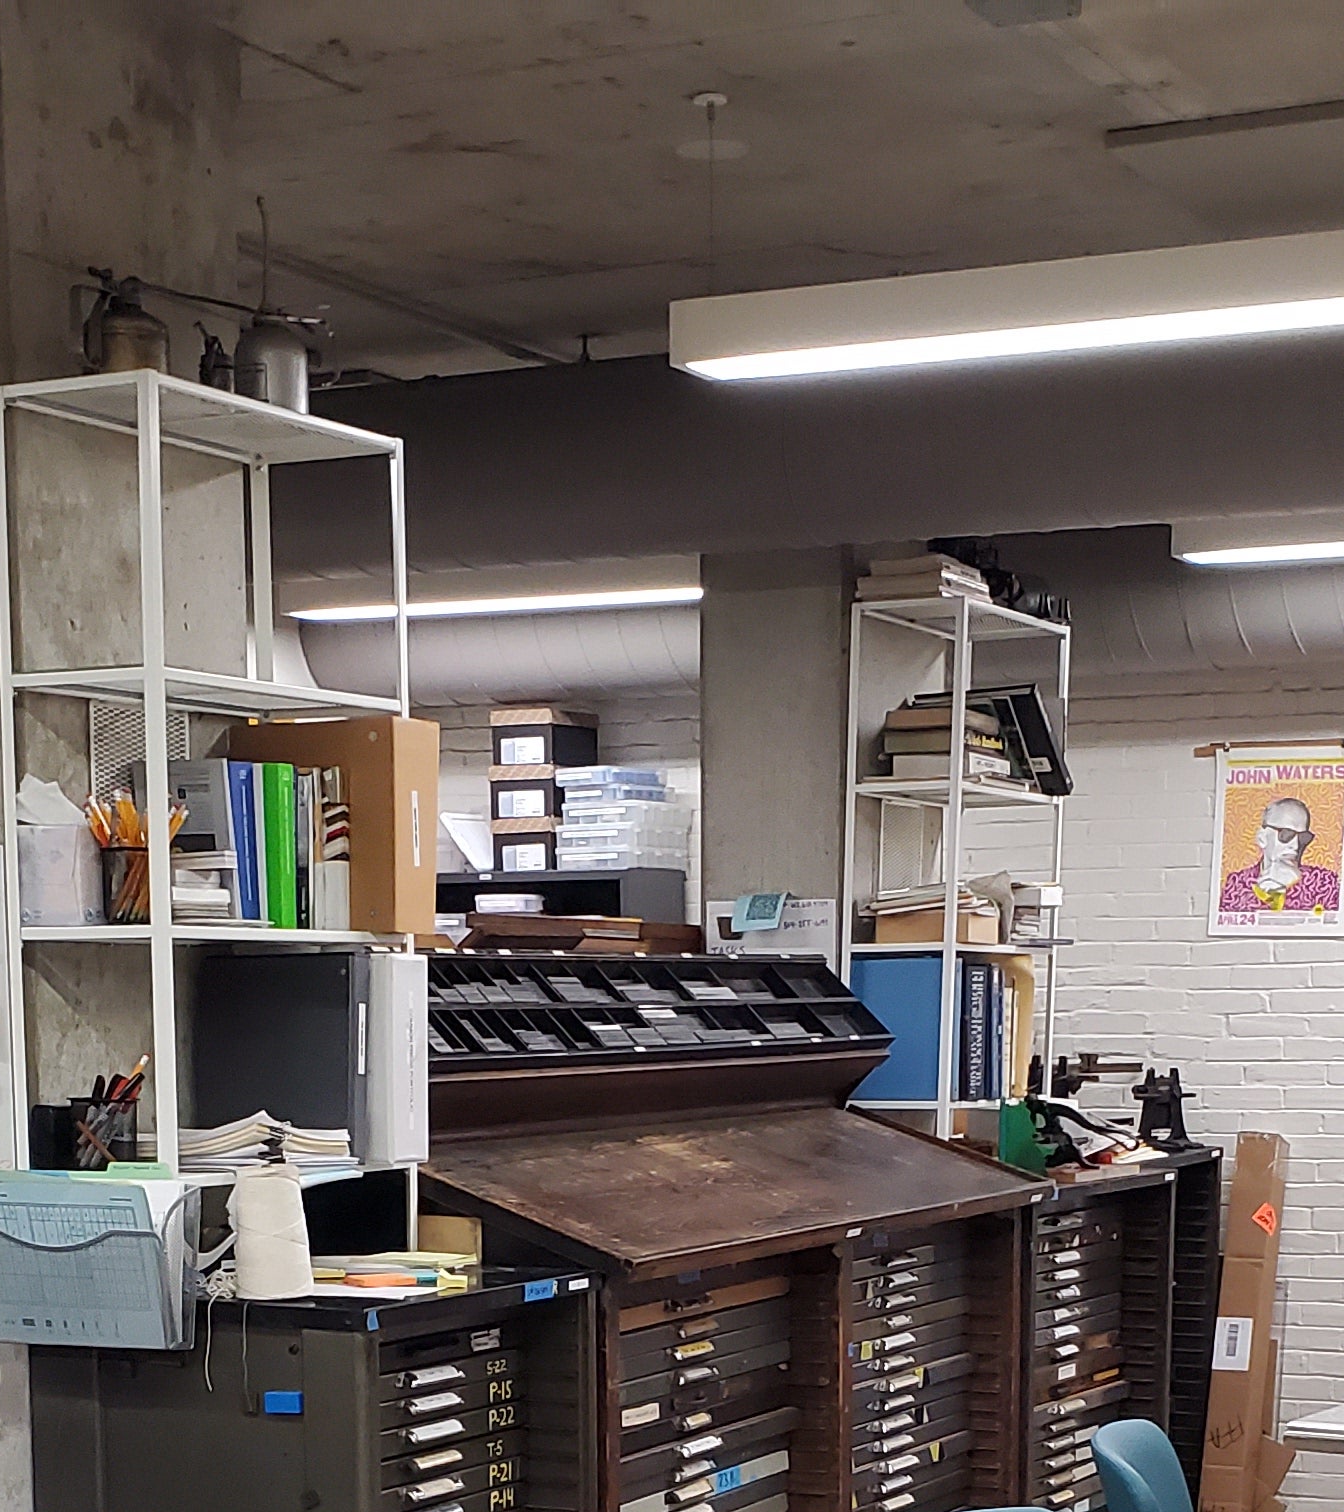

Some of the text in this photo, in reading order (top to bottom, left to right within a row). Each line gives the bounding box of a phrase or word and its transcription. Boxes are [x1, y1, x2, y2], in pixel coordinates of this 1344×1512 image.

[1226, 768, 1271, 785] JOHN
[1239, 913, 1256, 926] 24
[490, 1380, 512, 1403] P-15
[489, 1406, 515, 1433] P-22
[489, 1461, 512, 1487] P-21
[490, 1488, 514, 1512] P-14
